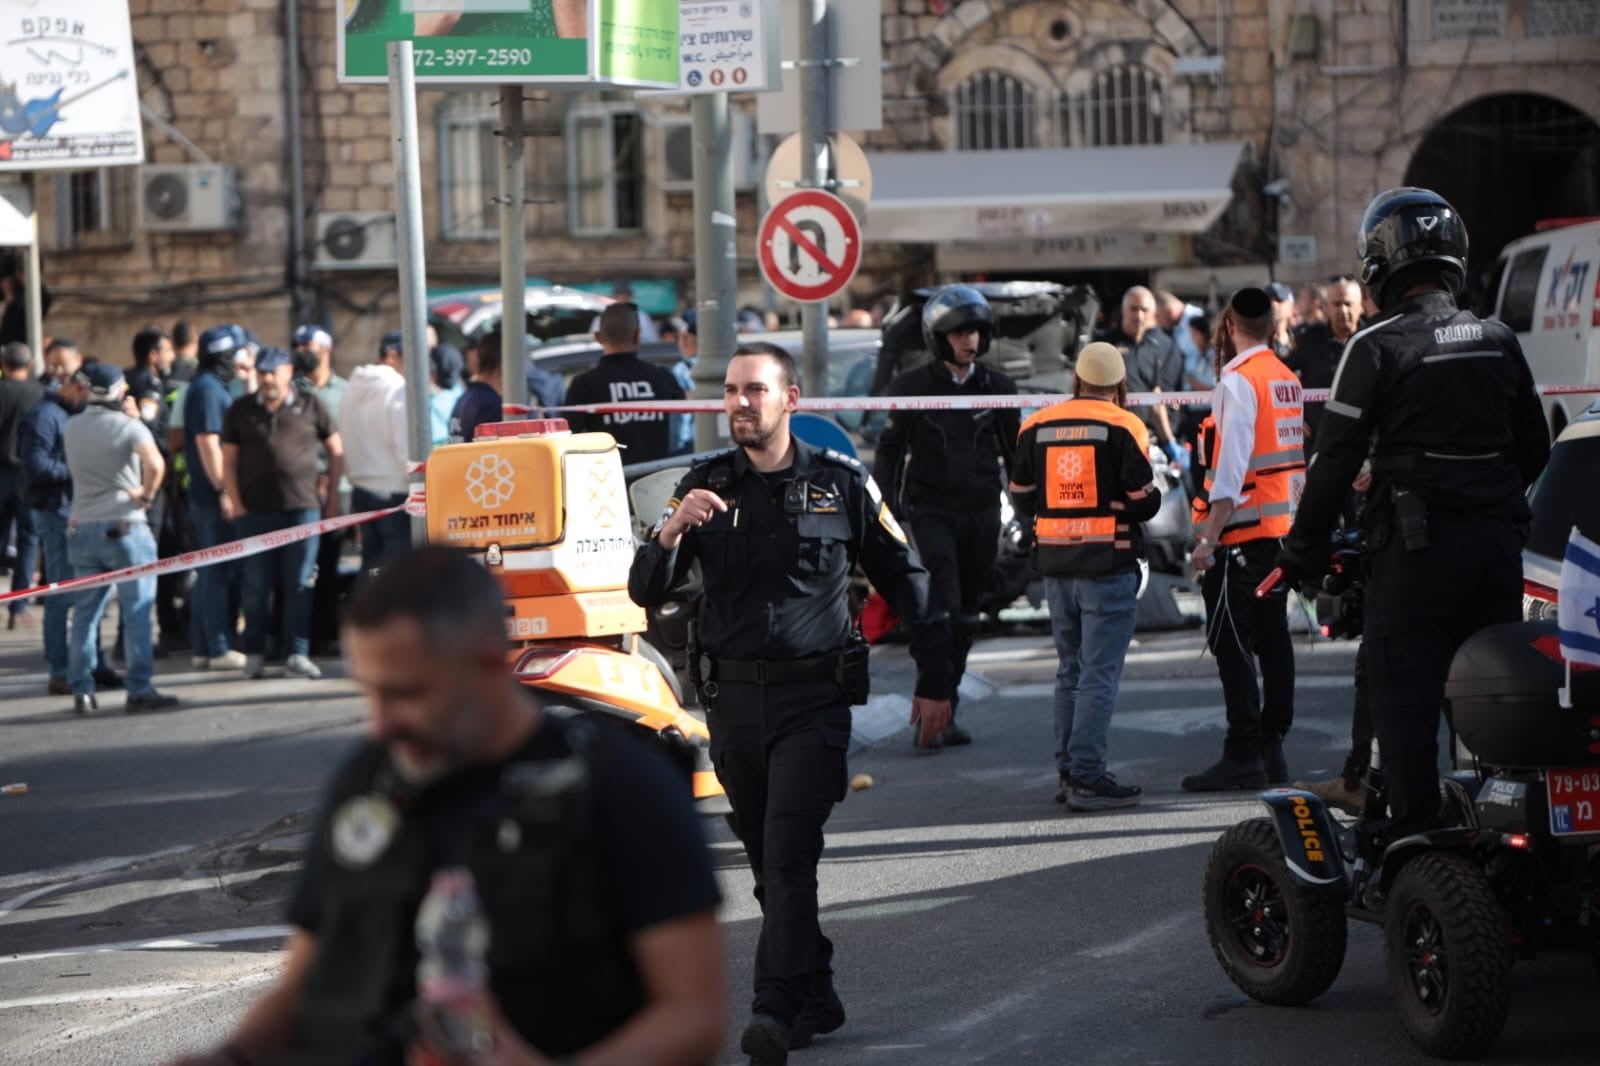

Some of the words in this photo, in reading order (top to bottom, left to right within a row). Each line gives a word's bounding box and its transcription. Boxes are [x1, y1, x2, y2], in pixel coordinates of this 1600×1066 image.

[701, 29, 753, 44] שירותים
[413, 48, 532, 66] 72-397-2590
[609, 381, 655, 402] בוחן
[1060, 490, 1084, 500] הצלה
[448, 515, 490, 530] הצלה
[493, 512, 536, 526] איחוד
[577, 538, 606, 554] הצלה
[1577, 800, 1592, 821] מ
[1287, 796, 1325, 862] POLICE
